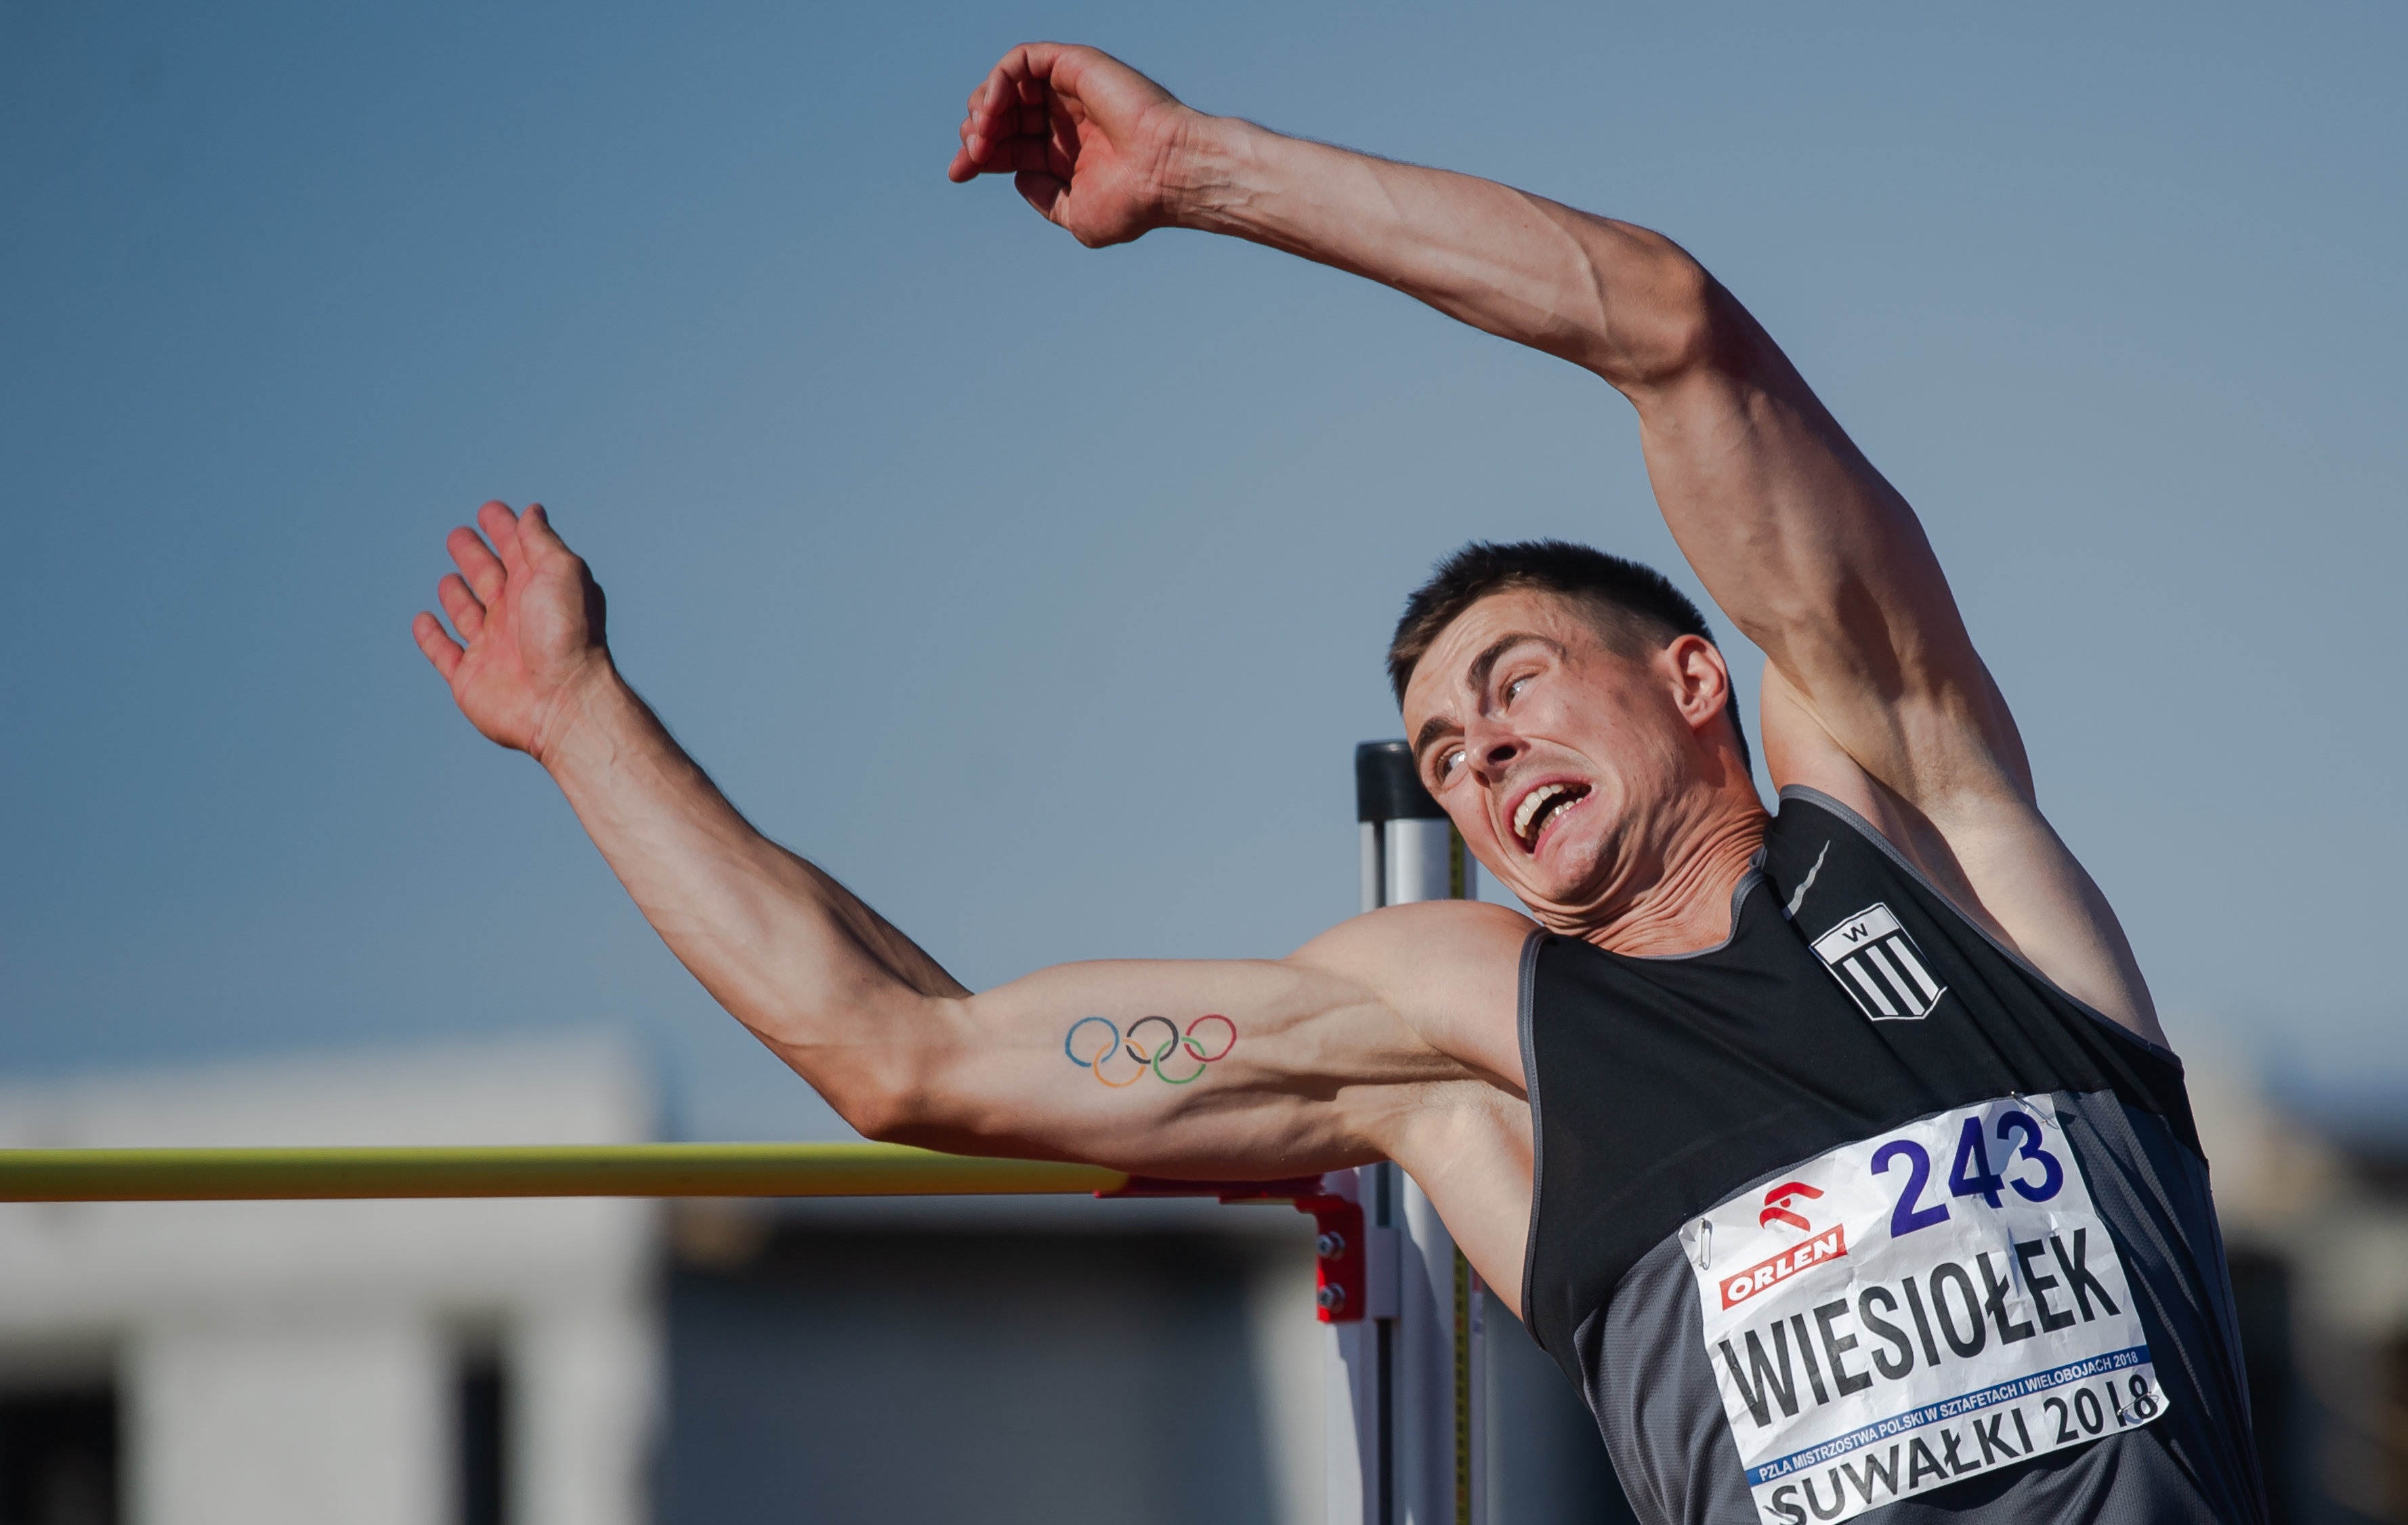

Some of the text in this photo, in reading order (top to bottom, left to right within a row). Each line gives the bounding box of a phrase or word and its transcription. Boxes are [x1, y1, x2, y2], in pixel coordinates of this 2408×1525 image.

[1842, 923, 1869, 942] W
[1870, 1110, 2064, 1238] 243
[1718, 1227, 2120, 1429] WIESIOŁEK
[1727, 1232, 1838, 1301] ORLEN
[1758, 1351, 2138, 1482] PZLA MISTRZOSTWA POLSKI W SZTAFETACH I WIELOBOJACH 2018
[1772, 1373, 2159, 1525] SUWAŁKI 2018
